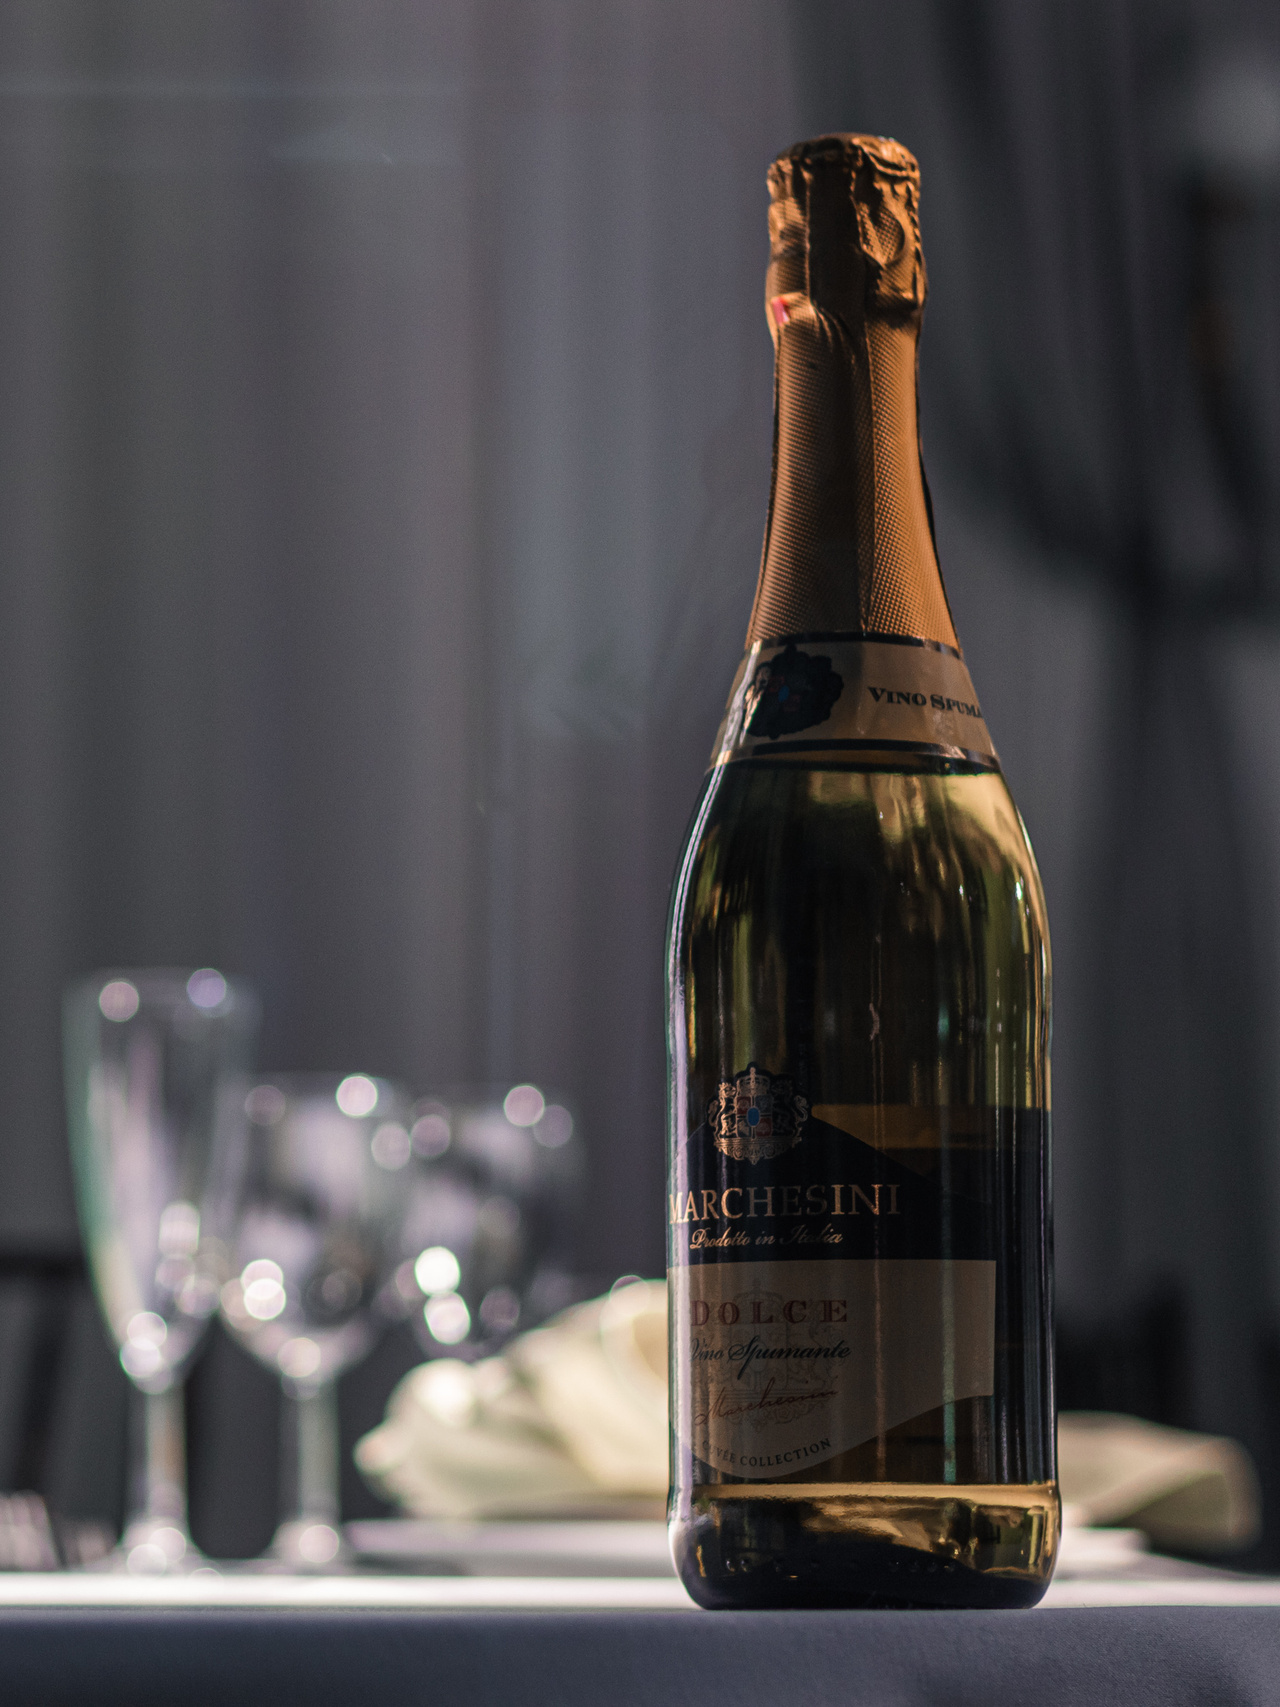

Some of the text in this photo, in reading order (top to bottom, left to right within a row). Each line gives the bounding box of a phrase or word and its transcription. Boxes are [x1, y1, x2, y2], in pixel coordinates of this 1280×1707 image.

[868, 686, 927, 706] VINO
[669, 1184, 901, 1225] MARCHESINI
[690, 1223, 844, 1249] Prodotto in Italia
[690, 1300, 848, 1326] DOLCE
[690, 1335, 852, 1380] Vino Spumante
[740, 1438, 832, 1467] COLLECTION
